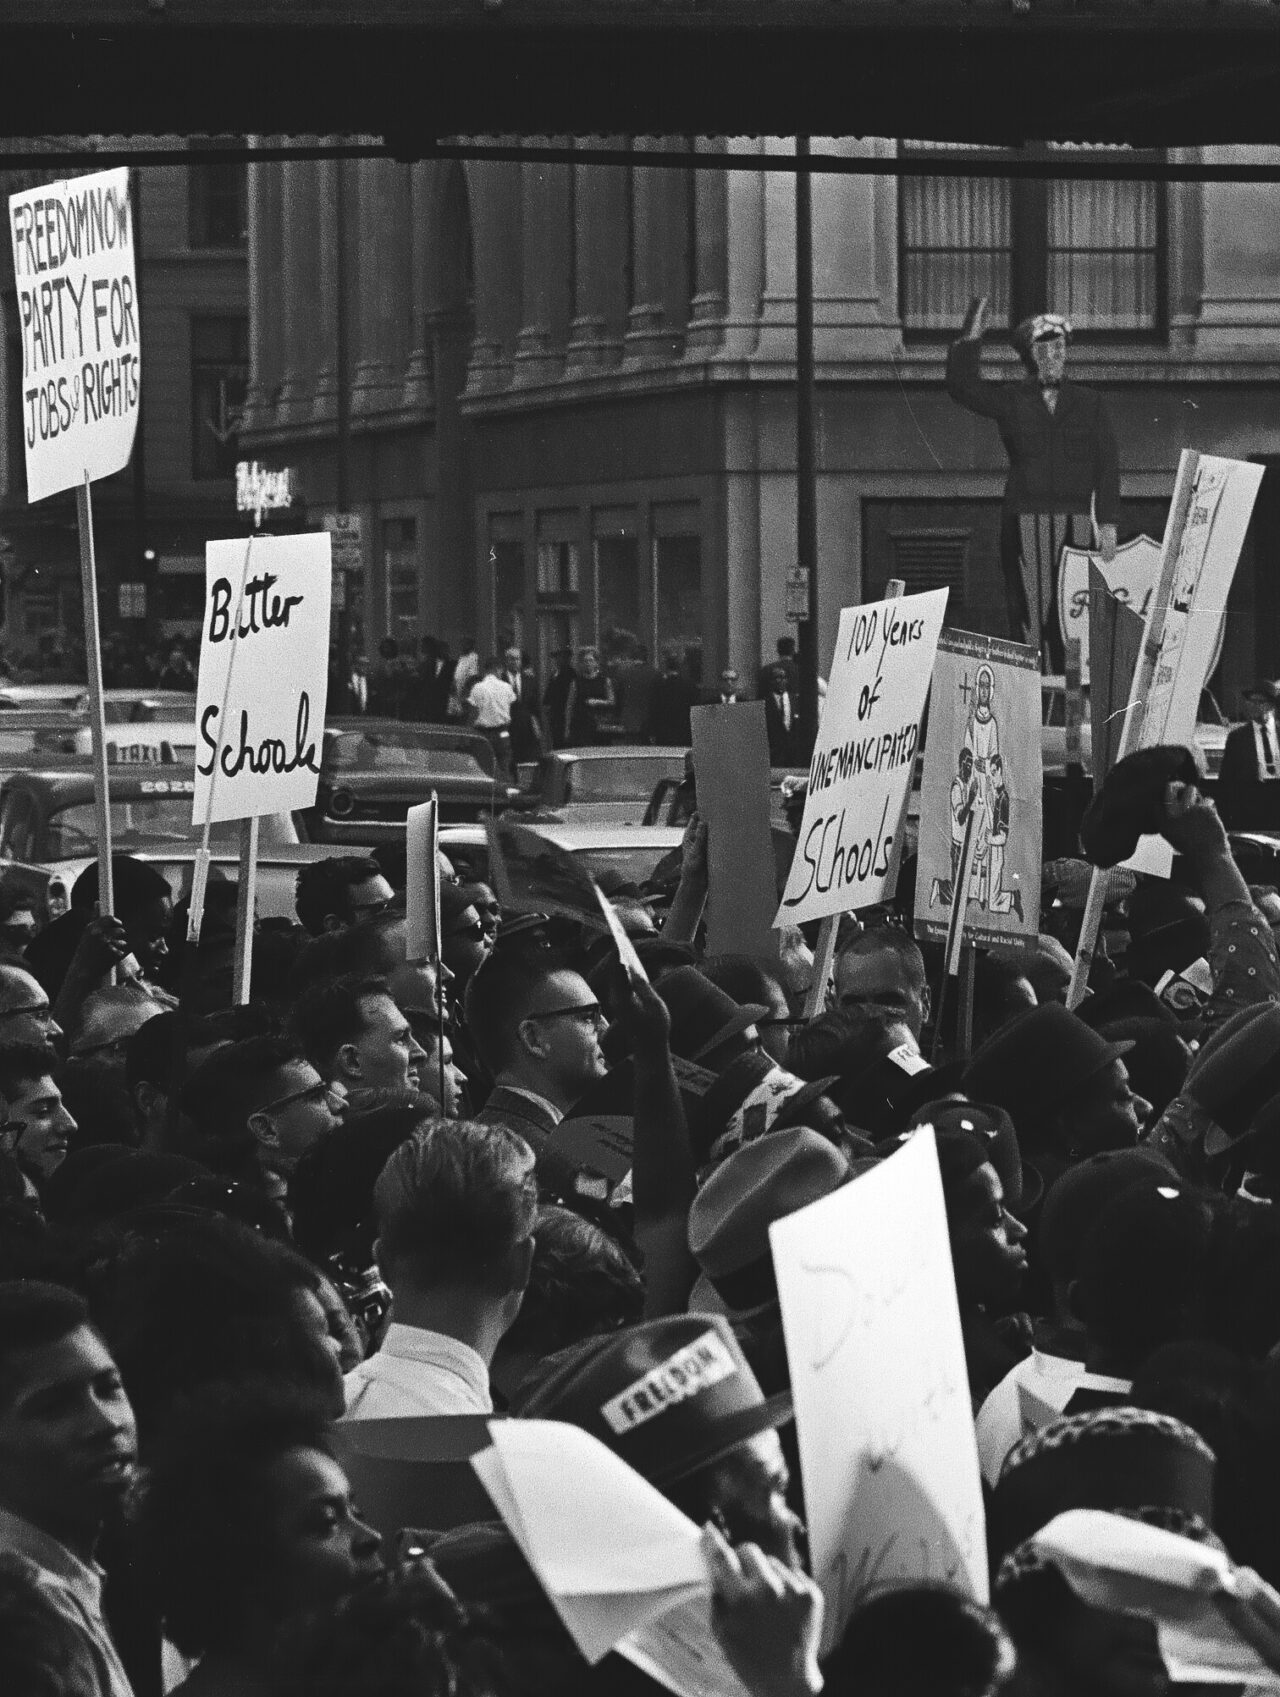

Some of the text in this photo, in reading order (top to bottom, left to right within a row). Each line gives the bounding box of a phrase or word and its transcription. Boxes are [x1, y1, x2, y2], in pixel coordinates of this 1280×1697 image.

[13, 188, 91, 276] FREEDOM
[21, 273, 138, 378] PARTY FOR
[25, 376, 72, 449] JOBS
[81, 353, 139, 424] RIGHTS
[847, 609, 878, 661] 100
[119, 744, 158, 761] TAXI
[197, 690, 321, 778] Schools
[808, 723, 918, 797] UNEMANCIPATED
